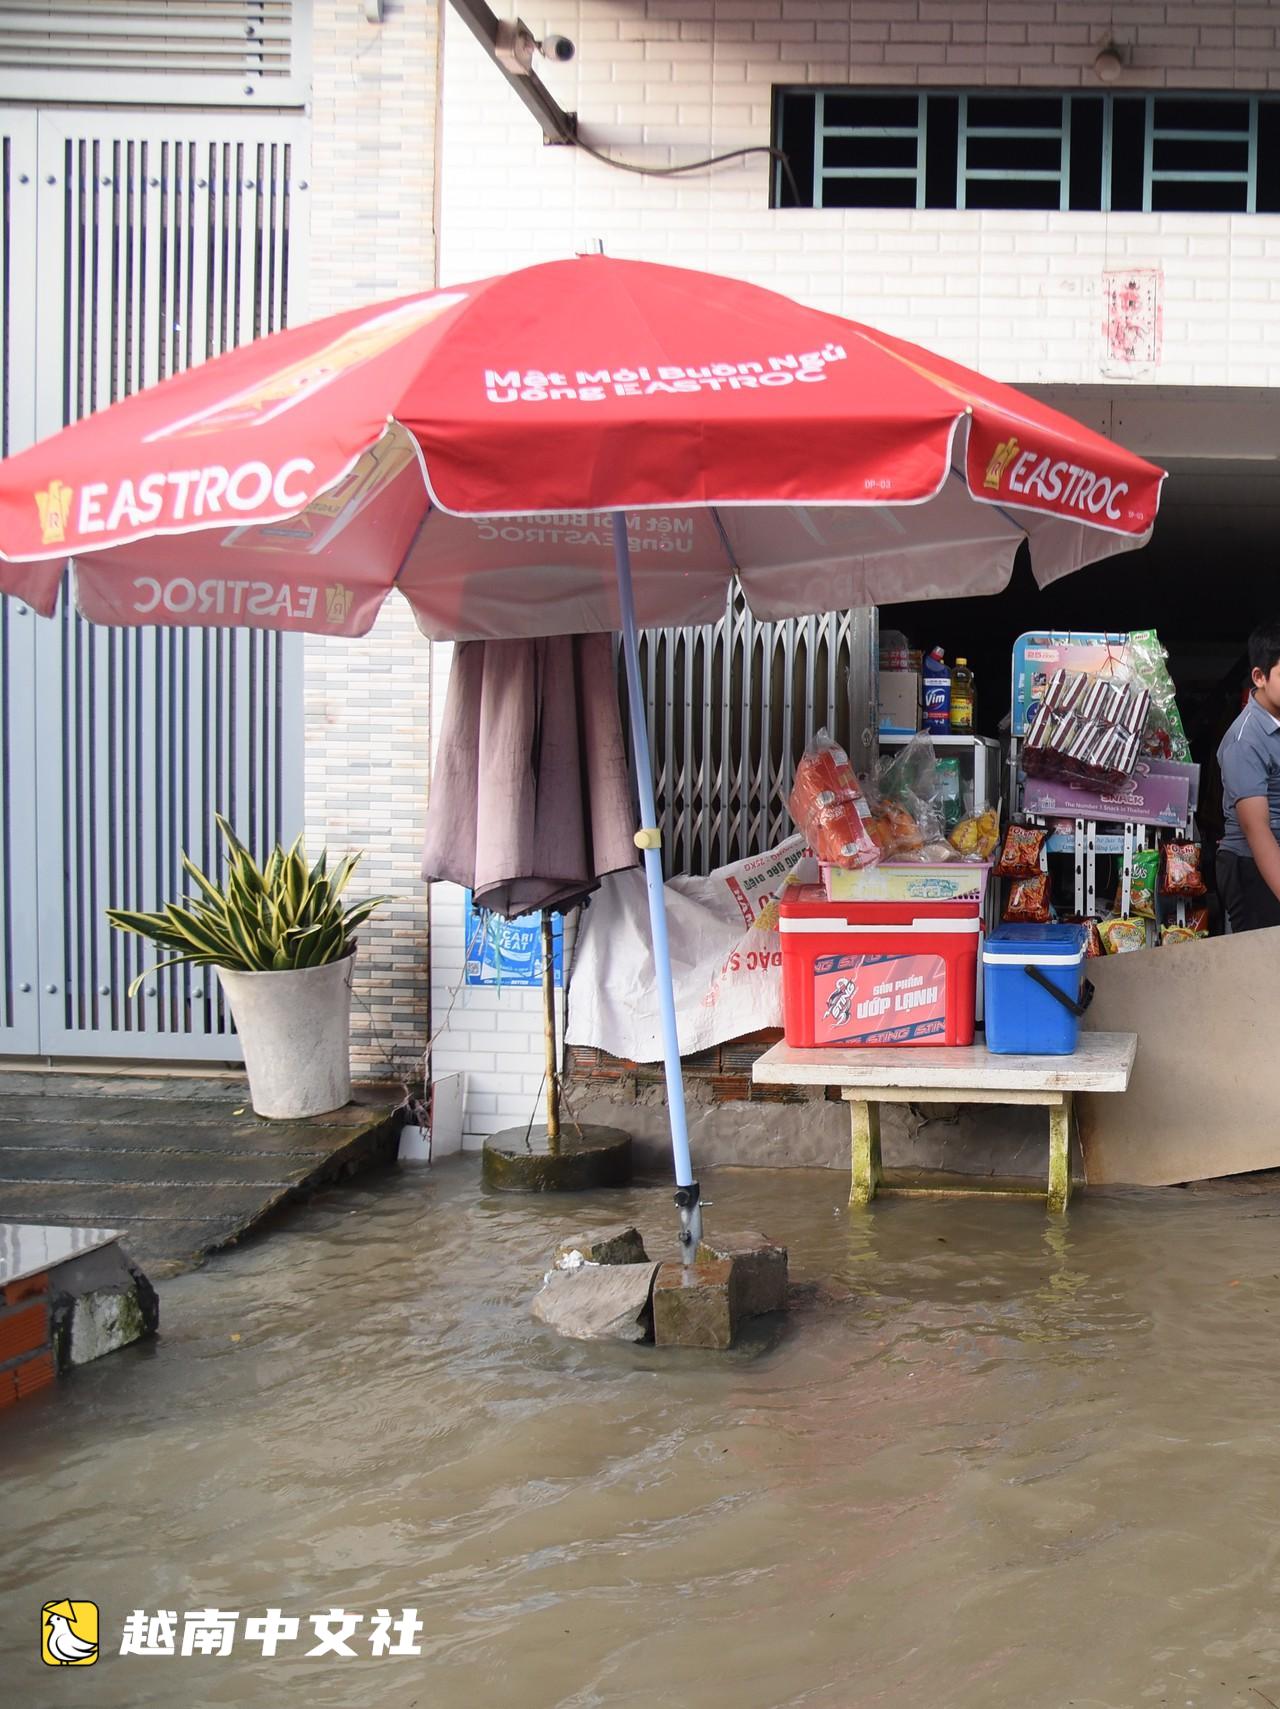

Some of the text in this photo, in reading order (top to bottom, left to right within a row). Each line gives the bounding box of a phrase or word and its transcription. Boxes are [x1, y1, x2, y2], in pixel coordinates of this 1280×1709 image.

[614, 366, 827, 397] EASTROC
[77, 458, 315, 534] EASTROC
[1008, 451, 1129, 521] EASTROC
[926, 693, 945, 707] Vim
[831, 980, 855, 1018] STING
[895, 986, 938, 1013] LẠNH
